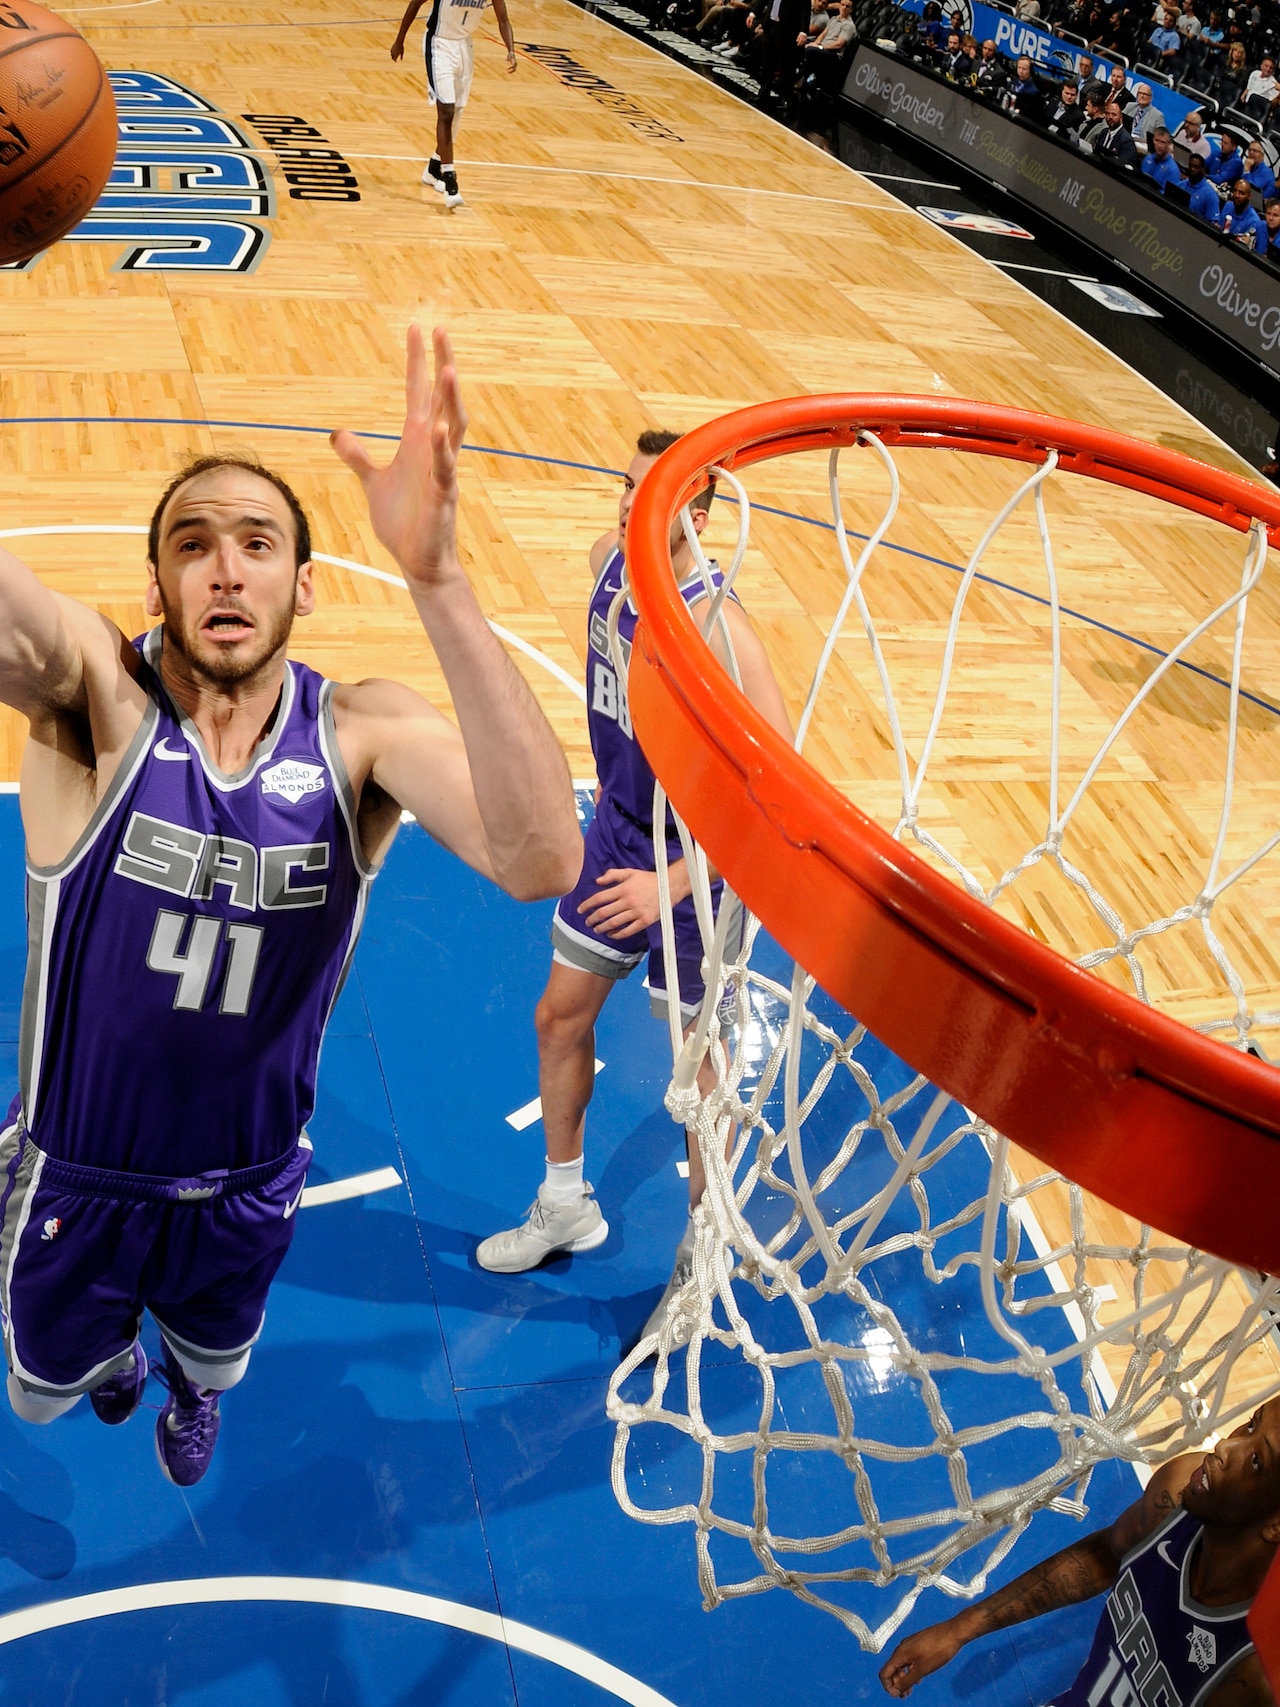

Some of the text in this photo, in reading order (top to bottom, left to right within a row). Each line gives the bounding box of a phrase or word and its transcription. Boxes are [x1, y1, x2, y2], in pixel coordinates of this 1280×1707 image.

[461, 10, 469, 25] 1
[995, 18, 1051, 68] PURE
[240, 114, 362, 202] ORLANDO
[959, 118, 980, 146] THE
[1059, 178, 1085, 207] ARE
[1080, 188, 1126, 234] Pure
[264, 780, 322, 791] ALMONDS
[271, 770, 310, 782] DIAMOND
[113, 810, 330, 912] SAC
[146, 907, 265, 1017] 41
[1187, 1632, 1208, 1671] ALMONDS
